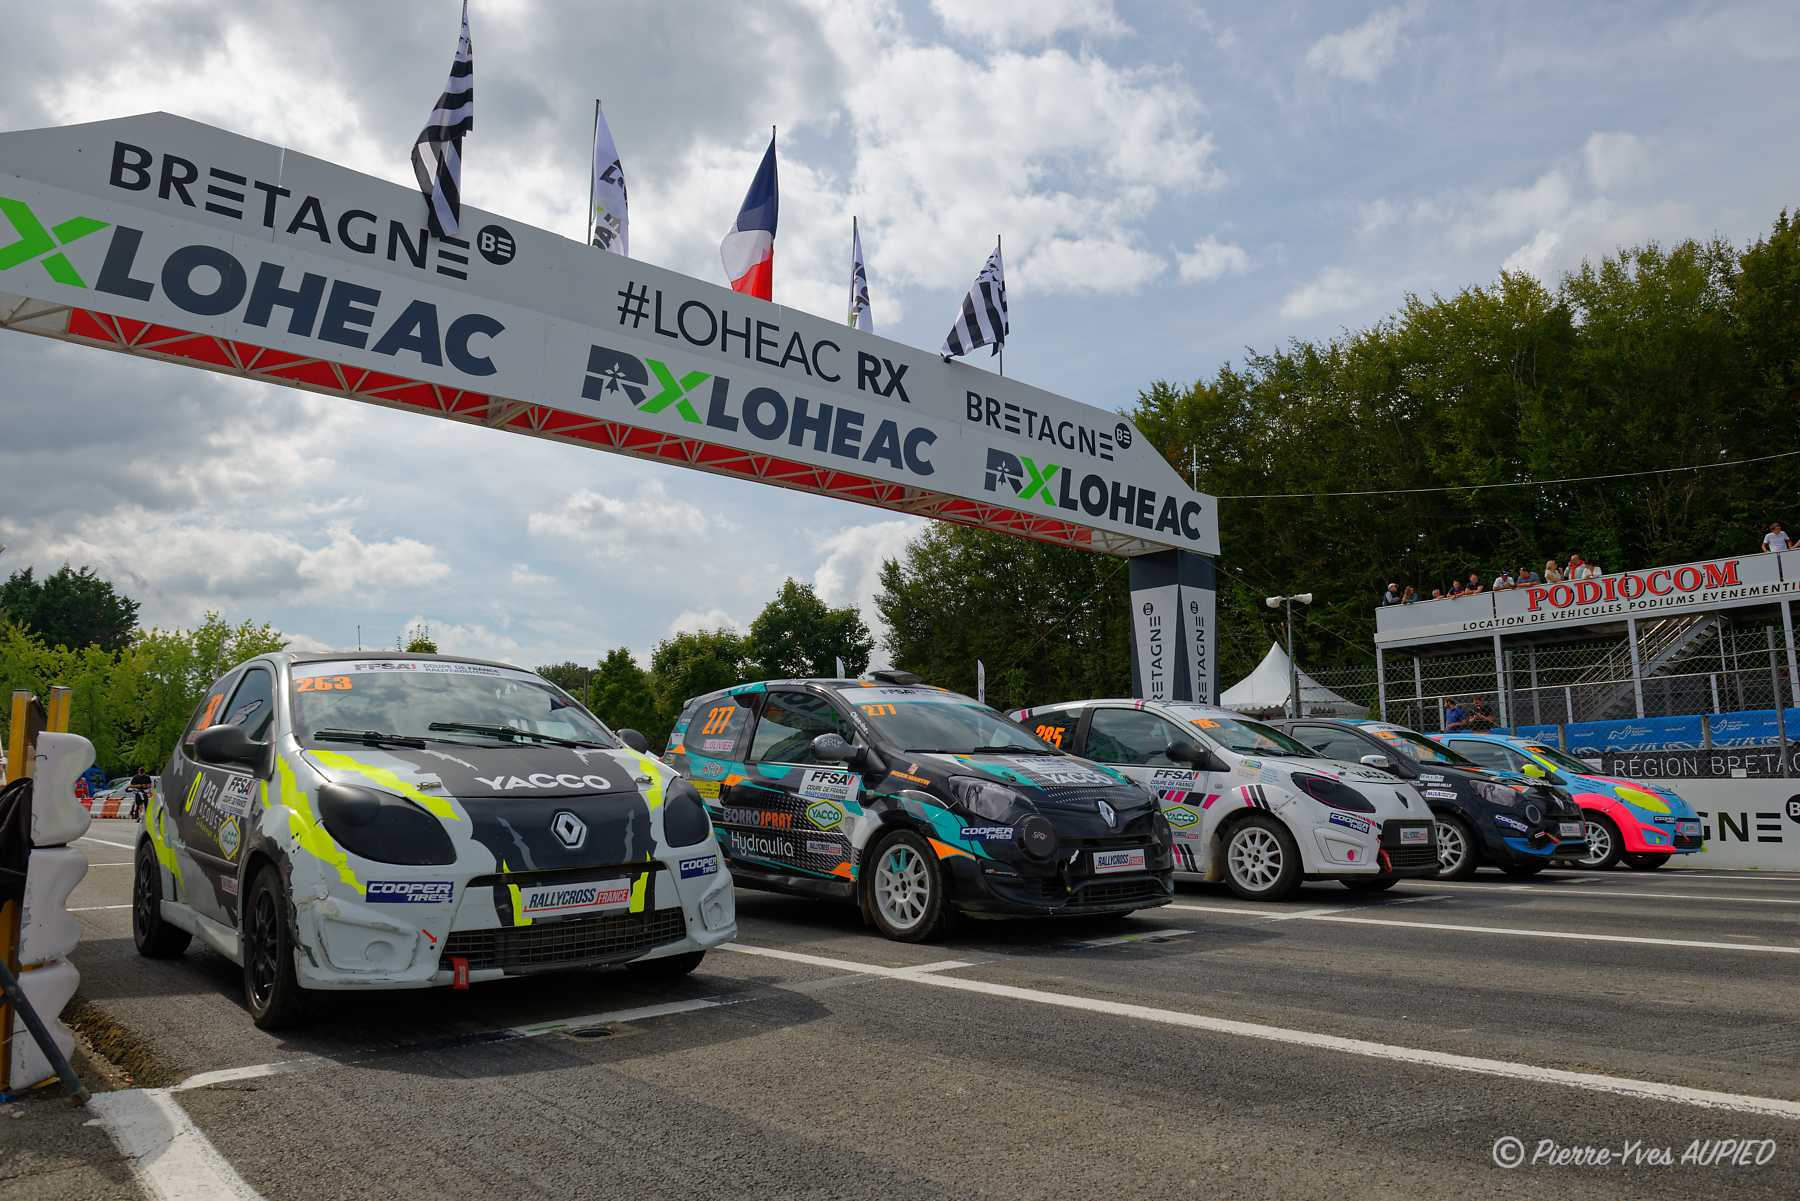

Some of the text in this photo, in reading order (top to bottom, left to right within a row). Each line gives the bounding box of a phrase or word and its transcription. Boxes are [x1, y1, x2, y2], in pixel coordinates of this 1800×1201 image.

[109, 140, 472, 281] BRETAGNE
[617, 280, 841, 384] #LOHEAC
[857, 351, 910, 404] RX
[966, 390, 1113, 462] BRETAGNE
[1525, 560, 1742, 612] PODIOCOM
[1463, 581, 1800, 631] LOCATION DE VEHICULES PODIUMS EVENEMENTI
[702, 705, 736, 735] 277
[1154, 769, 1193, 781] FFSA
[1613, 756, 1698, 778] RÉGION
[475, 773, 611, 790] YACCO
[811, 771, 849, 786] FFSA
[1040, 772, 1113, 785] YACCO
[812, 809, 840, 820] YACCO
[961, 827, 1014, 835] COOPER
[731, 831, 794, 857] Hydraulia
[681, 857, 717, 871] COOPER
[368, 883, 452, 894] COOPER
[406, 893, 450, 902] TIRES
[529, 888, 629, 909] RALLYCROSS FRANCE
